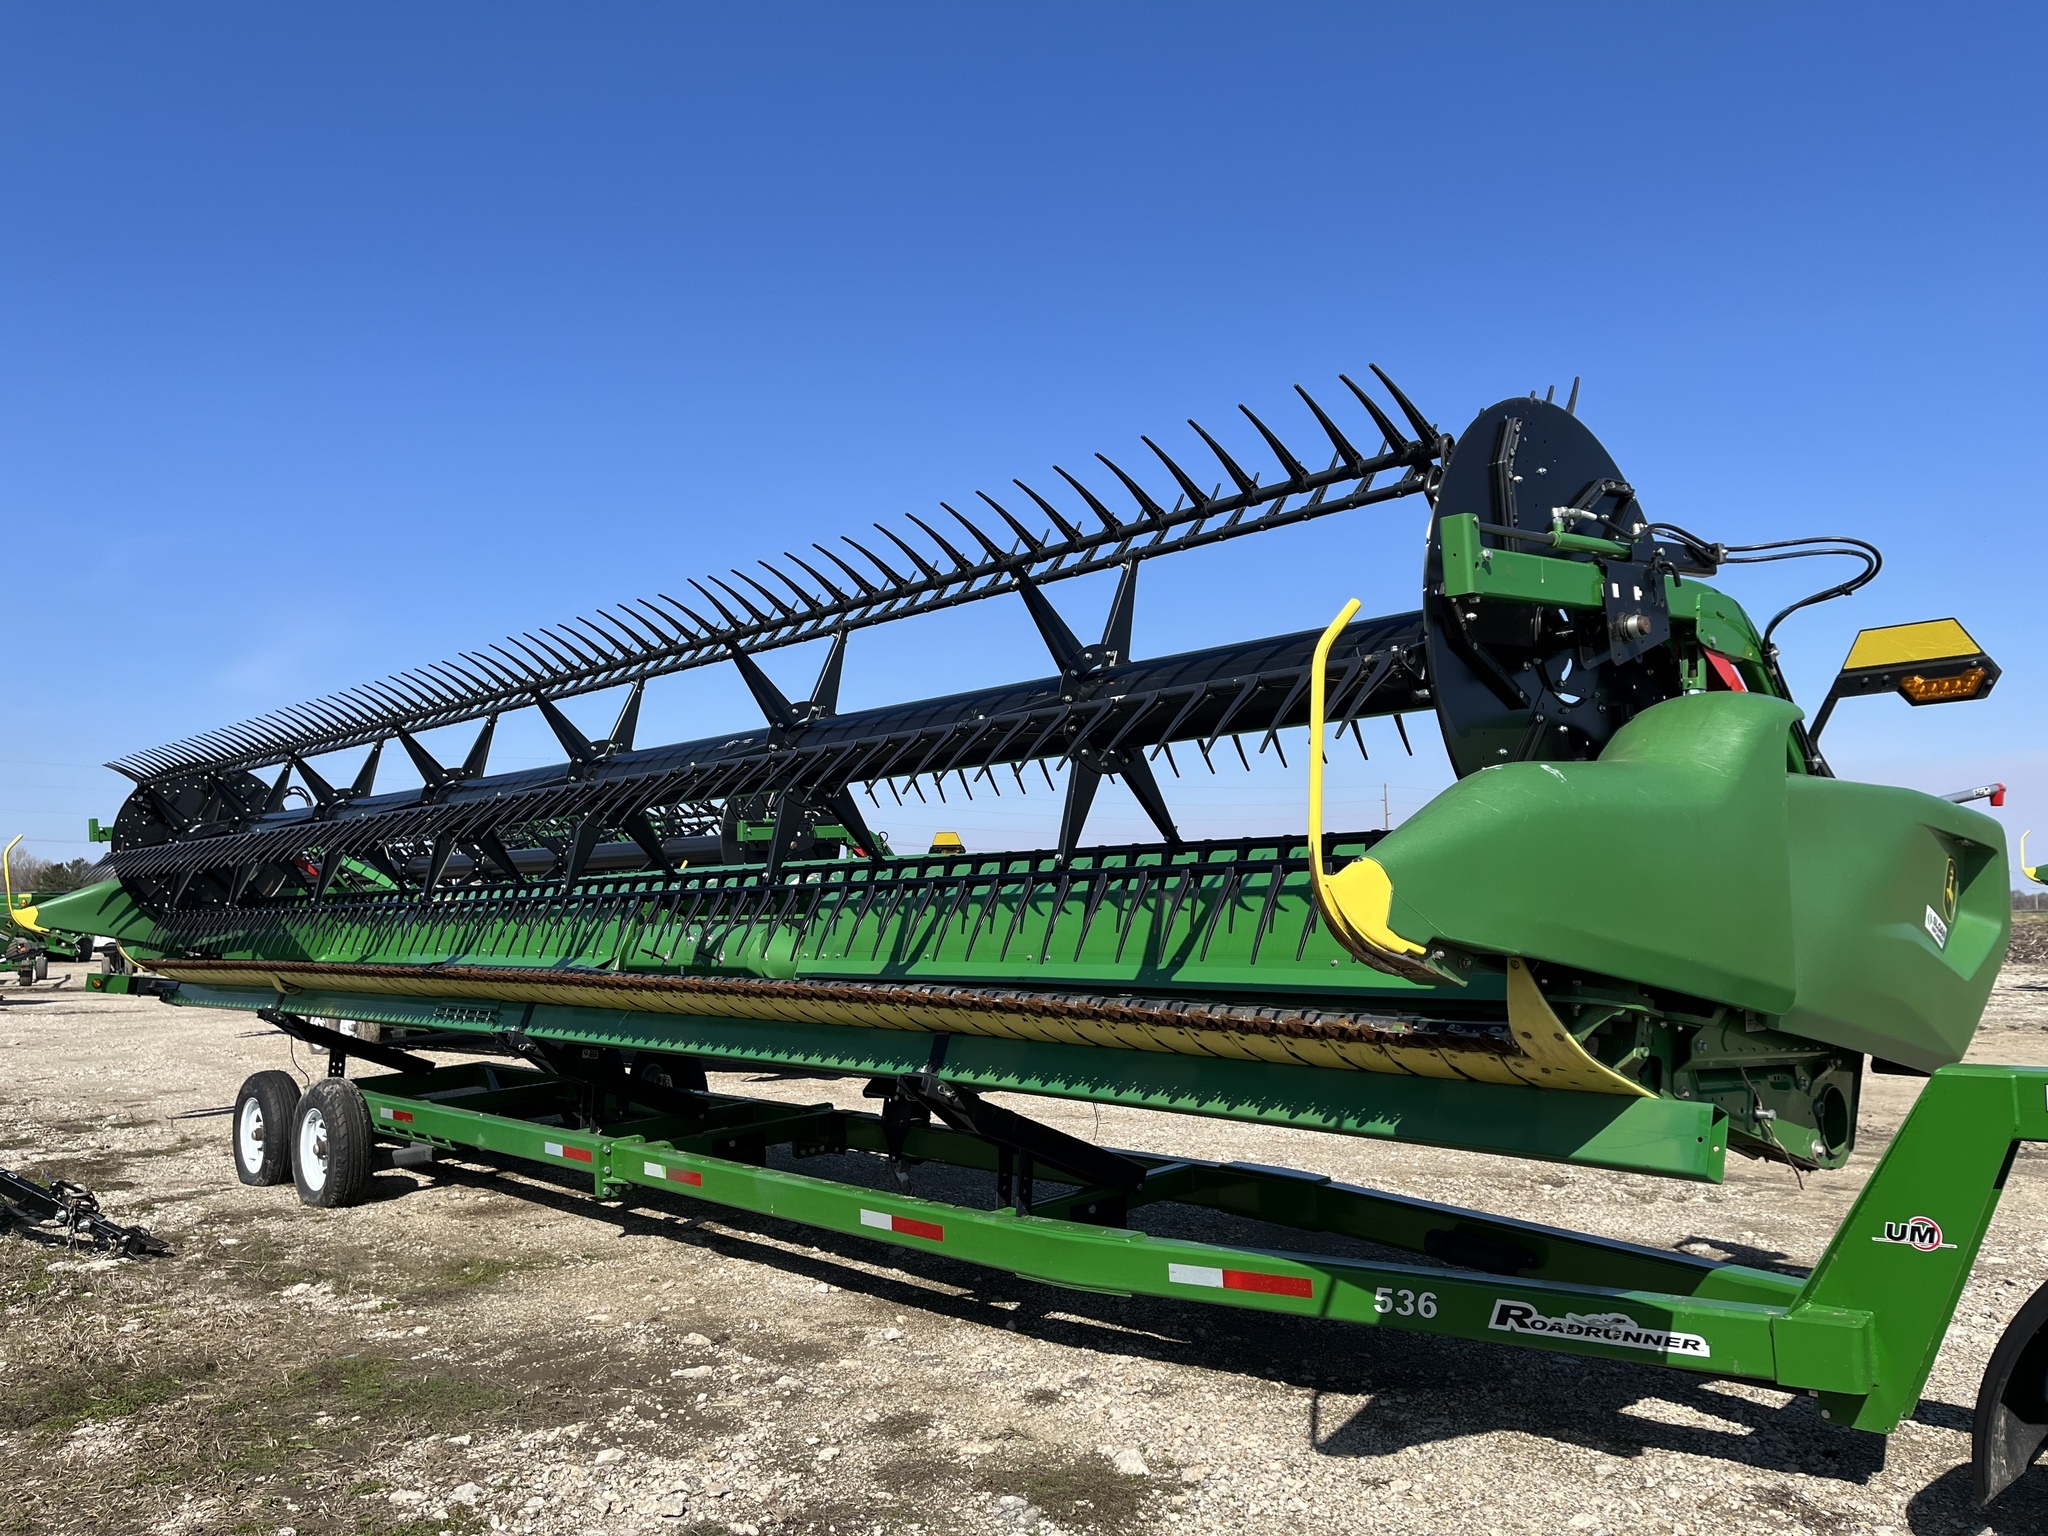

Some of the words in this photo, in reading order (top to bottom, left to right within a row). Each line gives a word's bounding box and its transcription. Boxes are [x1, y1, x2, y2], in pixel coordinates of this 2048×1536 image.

[1886, 1223, 1936, 1244] UM
[1373, 1286, 1438, 1319] 536
[1495, 1303, 1701, 1351] ROADRUNNER
